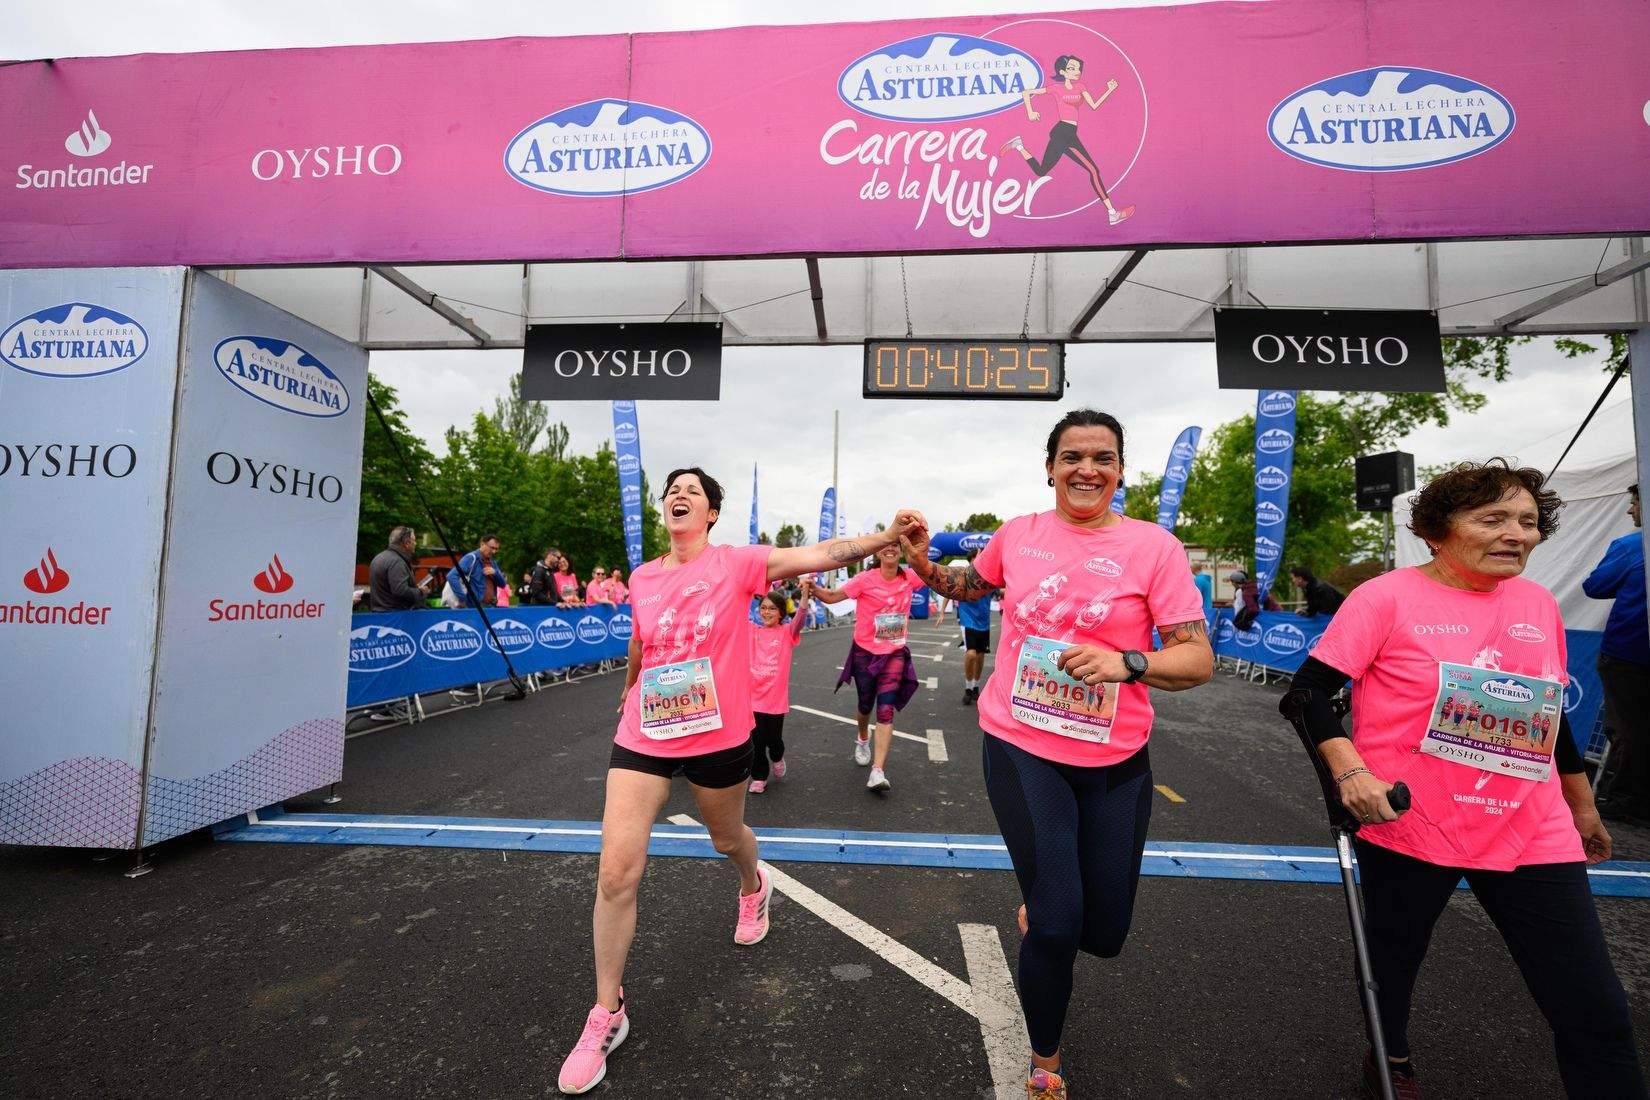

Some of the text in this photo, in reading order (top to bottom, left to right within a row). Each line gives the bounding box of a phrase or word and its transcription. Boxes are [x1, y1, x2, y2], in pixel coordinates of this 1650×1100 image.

[884, 59, 1020, 74] CENTRAL LECHERA
[853, 67, 1026, 101] ASTURIANA
[1322, 97, 1486, 114] CENTRAL LECHERA
[1286, 106, 1496, 145] ASTURIANA
[552, 128, 689, 145] CENTRAL LECHERA
[820, 118, 988, 166] Carrera
[251, 143, 402, 181] OYSHO
[519, 138, 695, 174] ASTURIANA
[16, 160, 154, 190] Santander
[859, 155, 1053, 239] de la Mujer
[33, 327, 135, 337] CENTRAL LECHERA
[9, 331, 137, 360] ASTURIANA
[1251, 333, 1409, 366] OYSHO
[251, 352, 340, 391] CENTRAL LECHERA
[554, 348, 692, 378] OYSHO
[877, 346, 1049, 389] 00:40:25
[226, 347, 342, 411] ASTURIANA
[206, 451, 343, 503] OYSHO
[1019, 547, 1055, 561] OYSHO
[208, 598, 326, 622] Santander
[540, 628, 573, 642] ASTURIANA
[1414, 624, 1469, 635] OYSHO
[349, 643, 412, 662] STURIANA
[427, 636, 479, 652] ASTURIANA
[1045, 680, 1085, 701] 016
[1484, 683, 1531, 701] ASTURIANA
[662, 694, 690, 709] 016
[1052, 699, 1071, 711] 2033
[1019, 710, 1049, 725] OYSHO
[1480, 713, 1527, 737] 016
[1068, 723, 1100, 737] Santander
[1431, 731, 1462, 744] CARRERA
[1474, 741, 1483, 749] LA
[1484, 743, 1506, 754] MUJER
[1489, 736, 1512, 747] 1733
[1438, 744, 1485, 763] OYSHO
[1510, 762, 1543, 775] Santander
[1453, 793, 1486, 805] CARRERA
[1487, 798, 1498, 806] DE
[1498, 799, 1508, 808] LA
[1484, 806, 1503, 815] 2024
